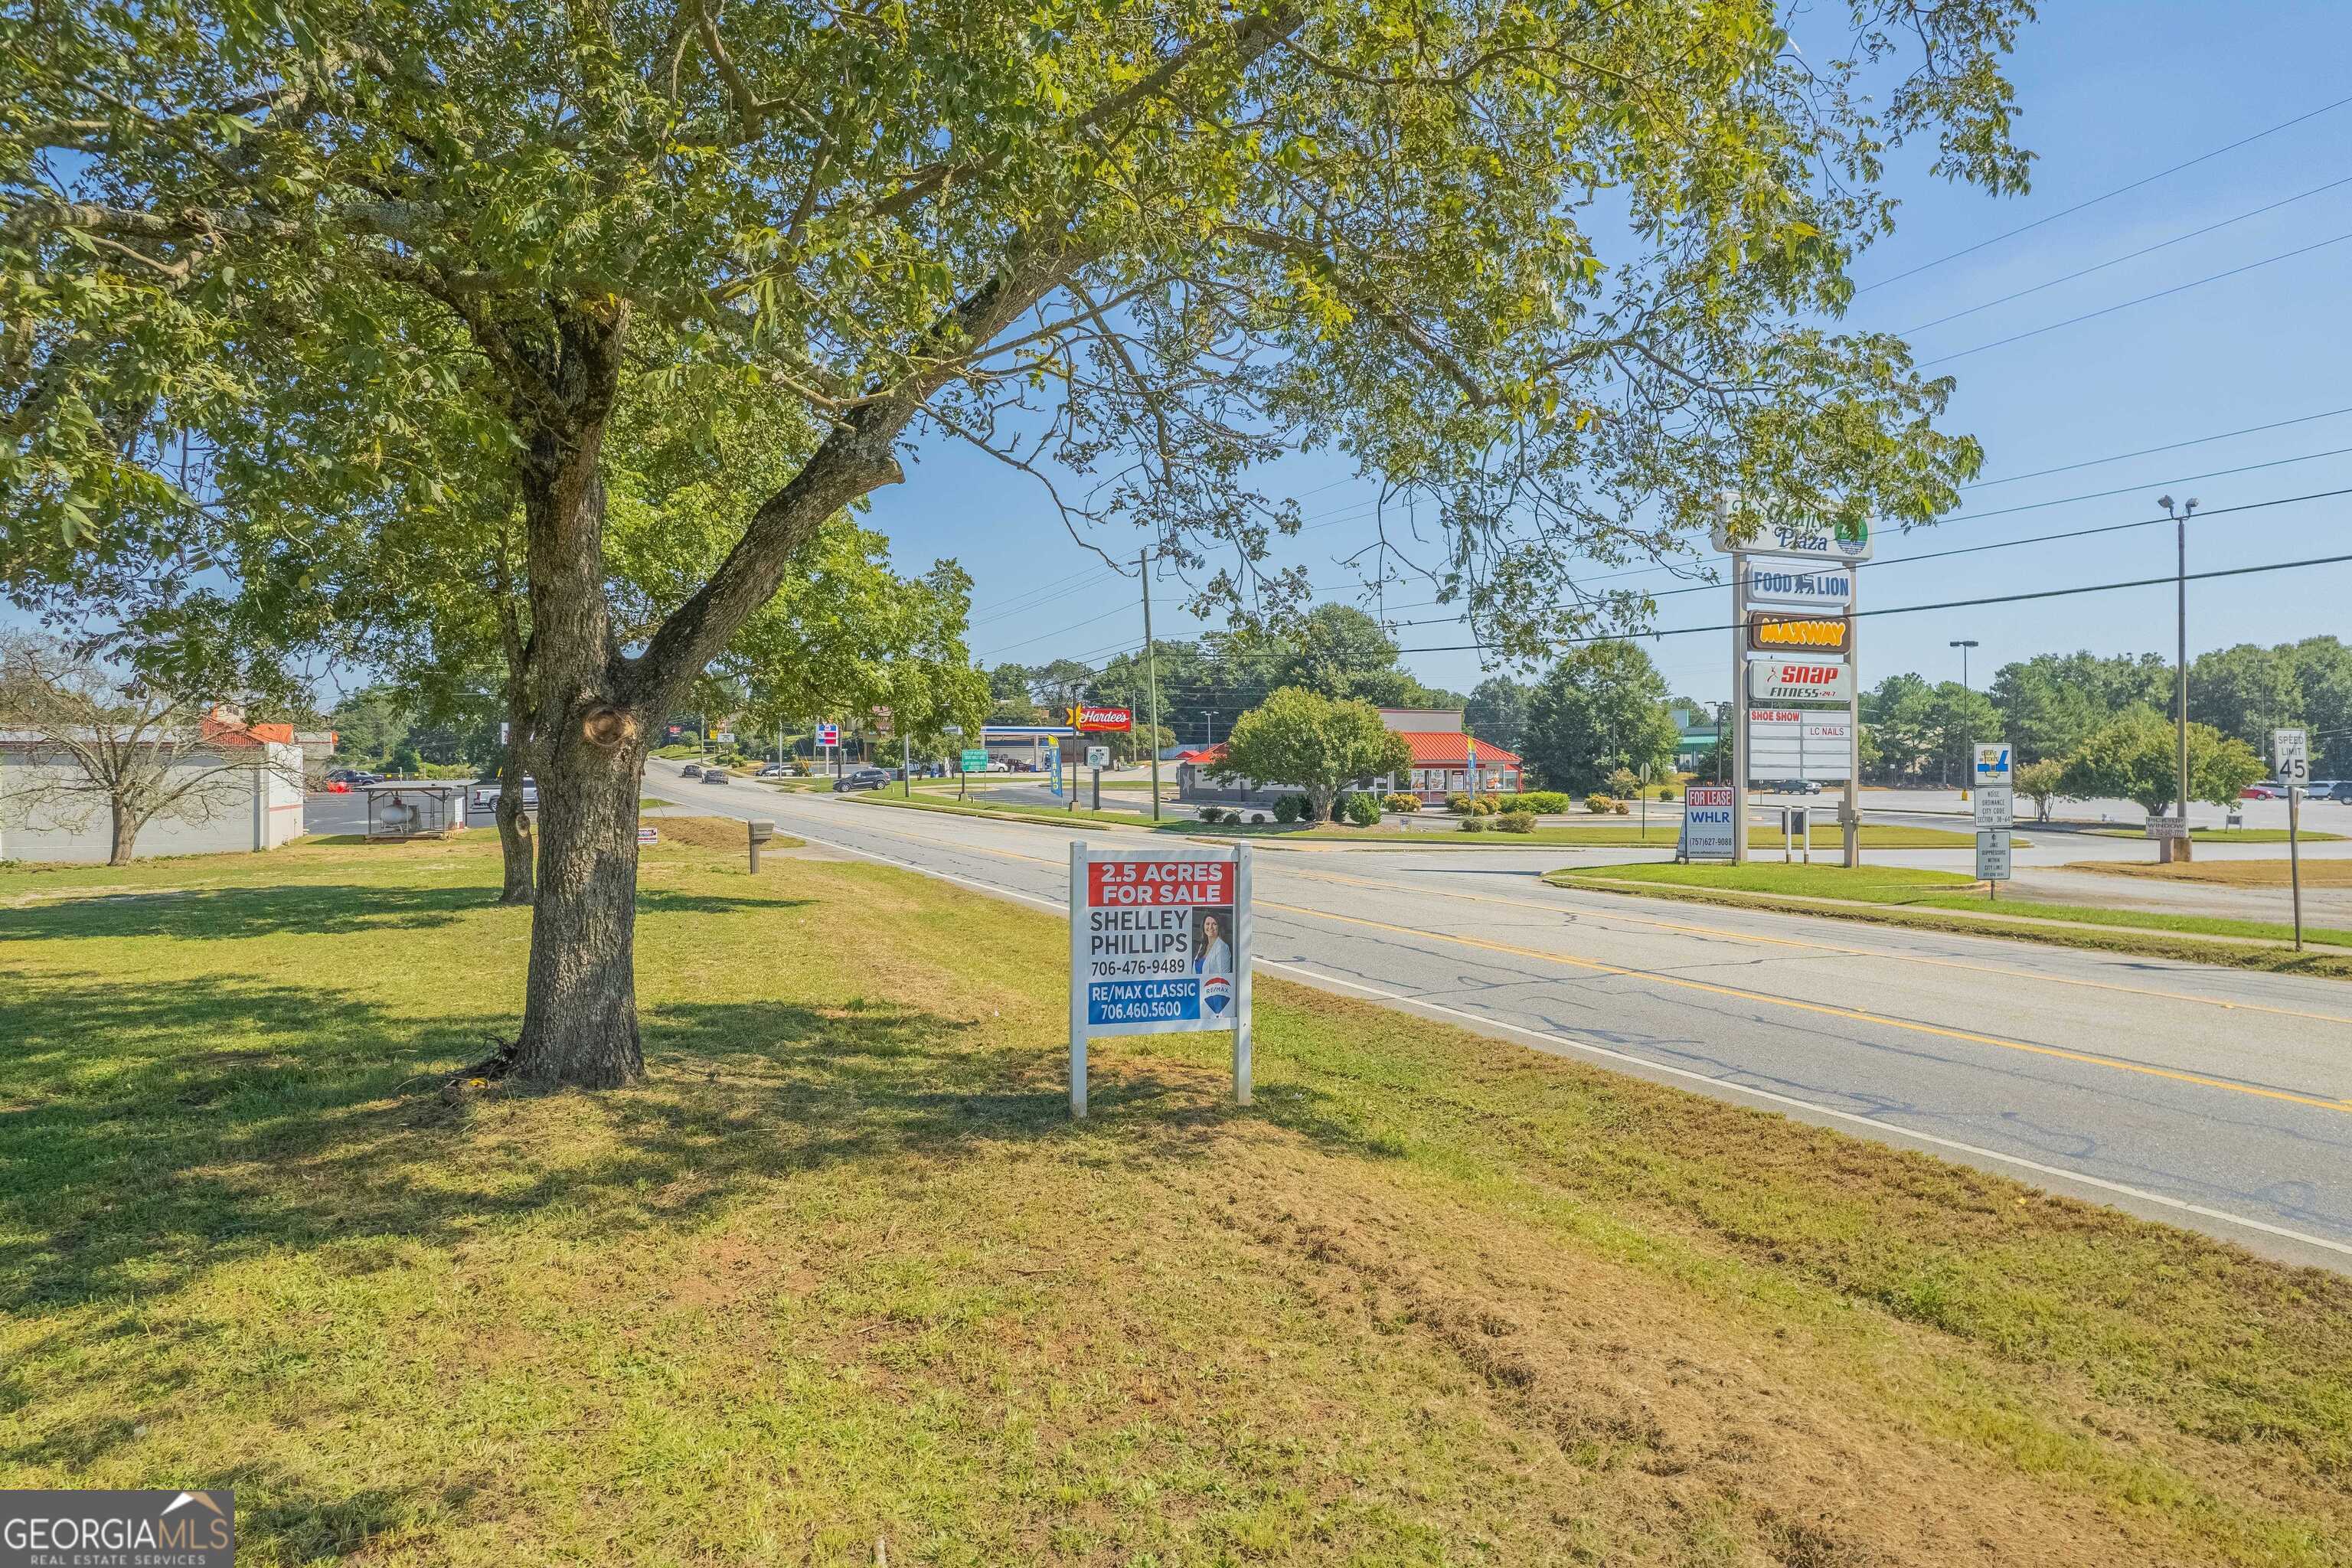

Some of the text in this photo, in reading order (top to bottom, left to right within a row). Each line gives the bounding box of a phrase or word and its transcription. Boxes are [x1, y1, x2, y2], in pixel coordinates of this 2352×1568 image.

[1754, 571, 1849, 596] FOOD LION
[1760, 617, 1846, 647] MAXWAY
[1079, 710, 1130, 723] Hardee's
[1751, 710, 1799, 722] SHOE SHOW
[1810, 727, 1844, 736] LC NAILS
[2278, 736, 2304, 744] SPEED
[2282, 747, 2302, 756] LIMIT
[2279, 760, 2305, 778] 45
[1690, 791, 1731, 805] FOR LEASE
[1690, 812, 1730, 823] WHLR
[1101, 864, 1223, 882] 2.5 ACRES
[1102, 884, 1220, 904] FOR SALE
[1090, 910, 1188, 932] SHELLEY
[1091, 933, 1187, 956] PHILLIPS
[1091, 959, 1185, 976] 706-476-9489
[1093, 983, 1196, 1003] RE/MAX CLASSIC
[1206, 985, 1229, 994] RE/MAX
[1101, 1001, 1181, 1020] 706.460.5600
